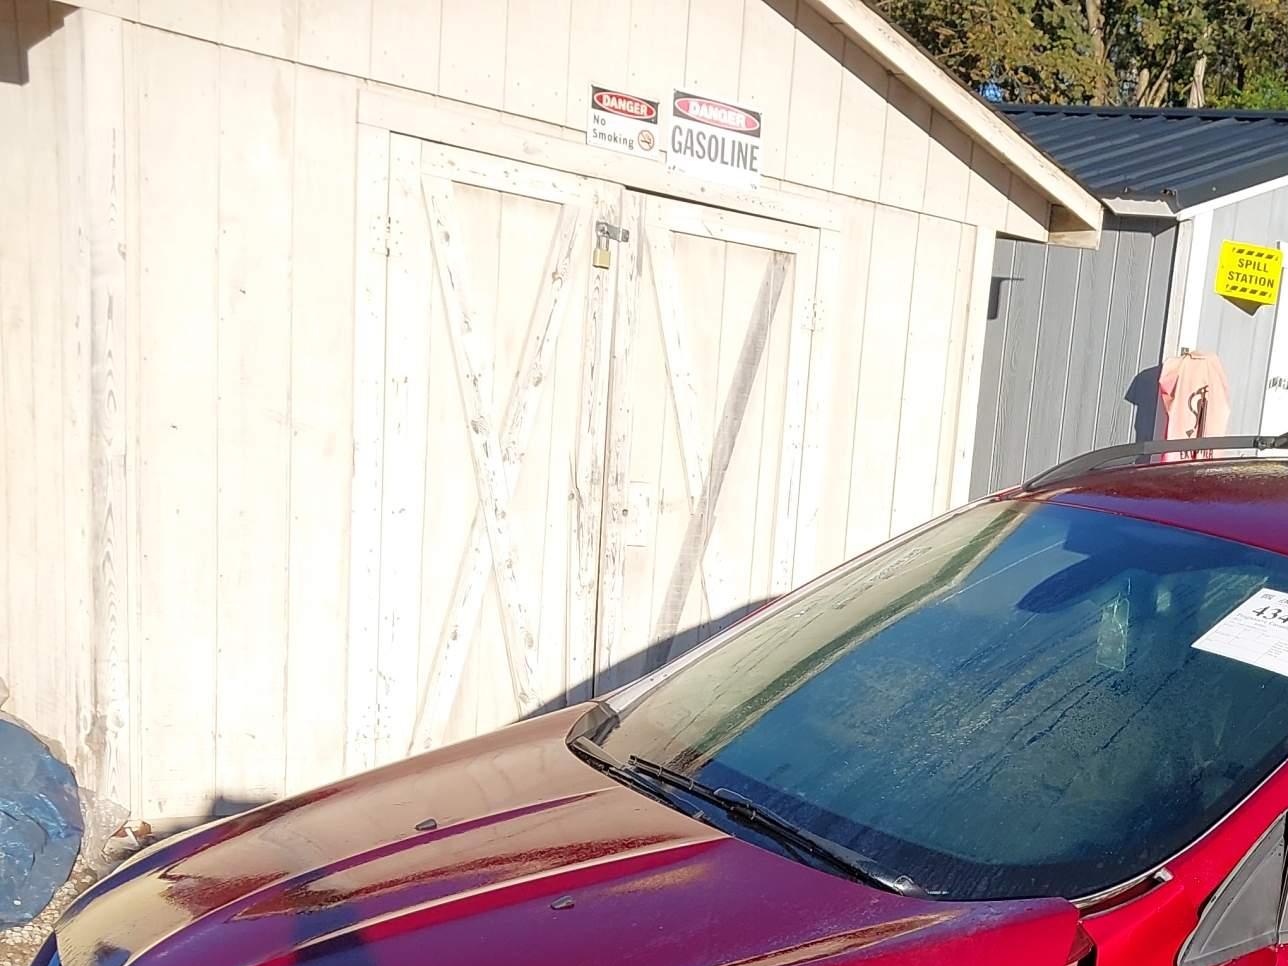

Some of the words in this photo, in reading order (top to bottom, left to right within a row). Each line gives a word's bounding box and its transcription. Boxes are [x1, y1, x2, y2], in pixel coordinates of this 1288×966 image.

[602, 94, 648, 117] DANGER
[688, 100, 746, 128] DANGER
[593, 114, 606, 126] No
[592, 128, 634, 150] Smoking
[671, 124, 760, 173] GASOLINE
[1237, 257, 1269, 273] SPILL
[1227, 270, 1275, 289] STATION
